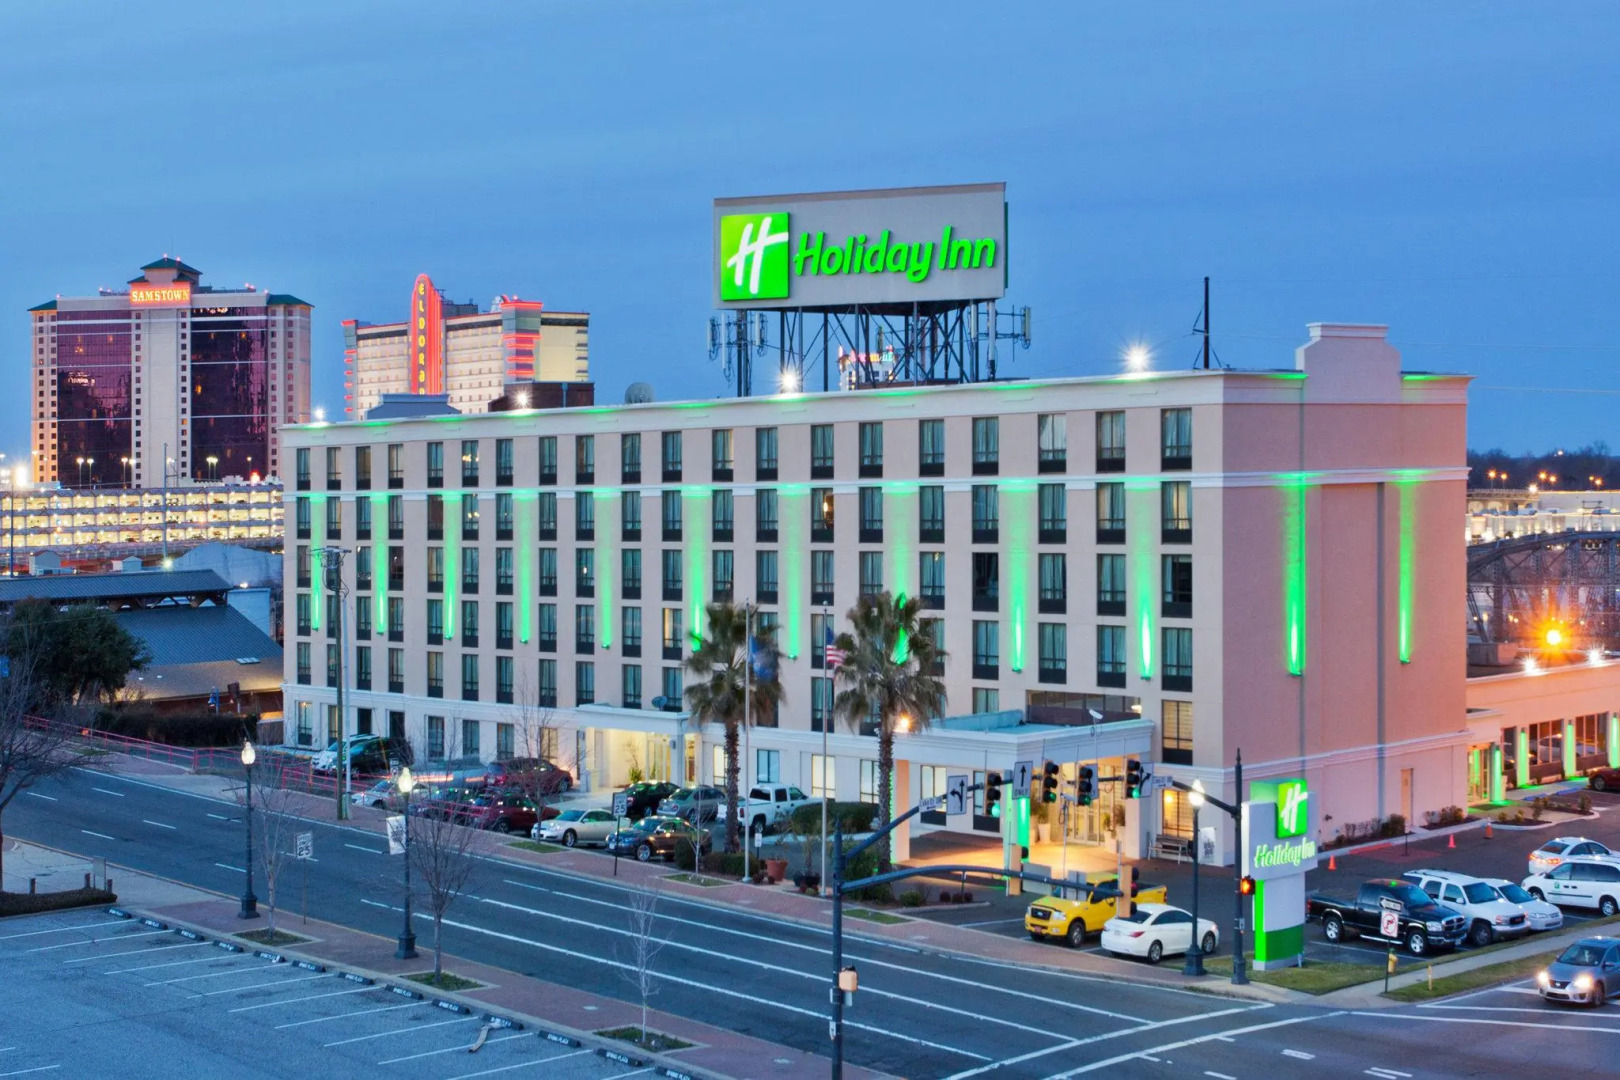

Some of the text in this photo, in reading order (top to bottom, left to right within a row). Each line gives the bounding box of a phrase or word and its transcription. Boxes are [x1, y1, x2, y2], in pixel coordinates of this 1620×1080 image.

[793, 225, 996, 283] Holiday Inn
[614, 804, 626, 814] 25
[298, 845, 310, 857] 25
[1254, 837, 1317, 869] Holiday Inn
